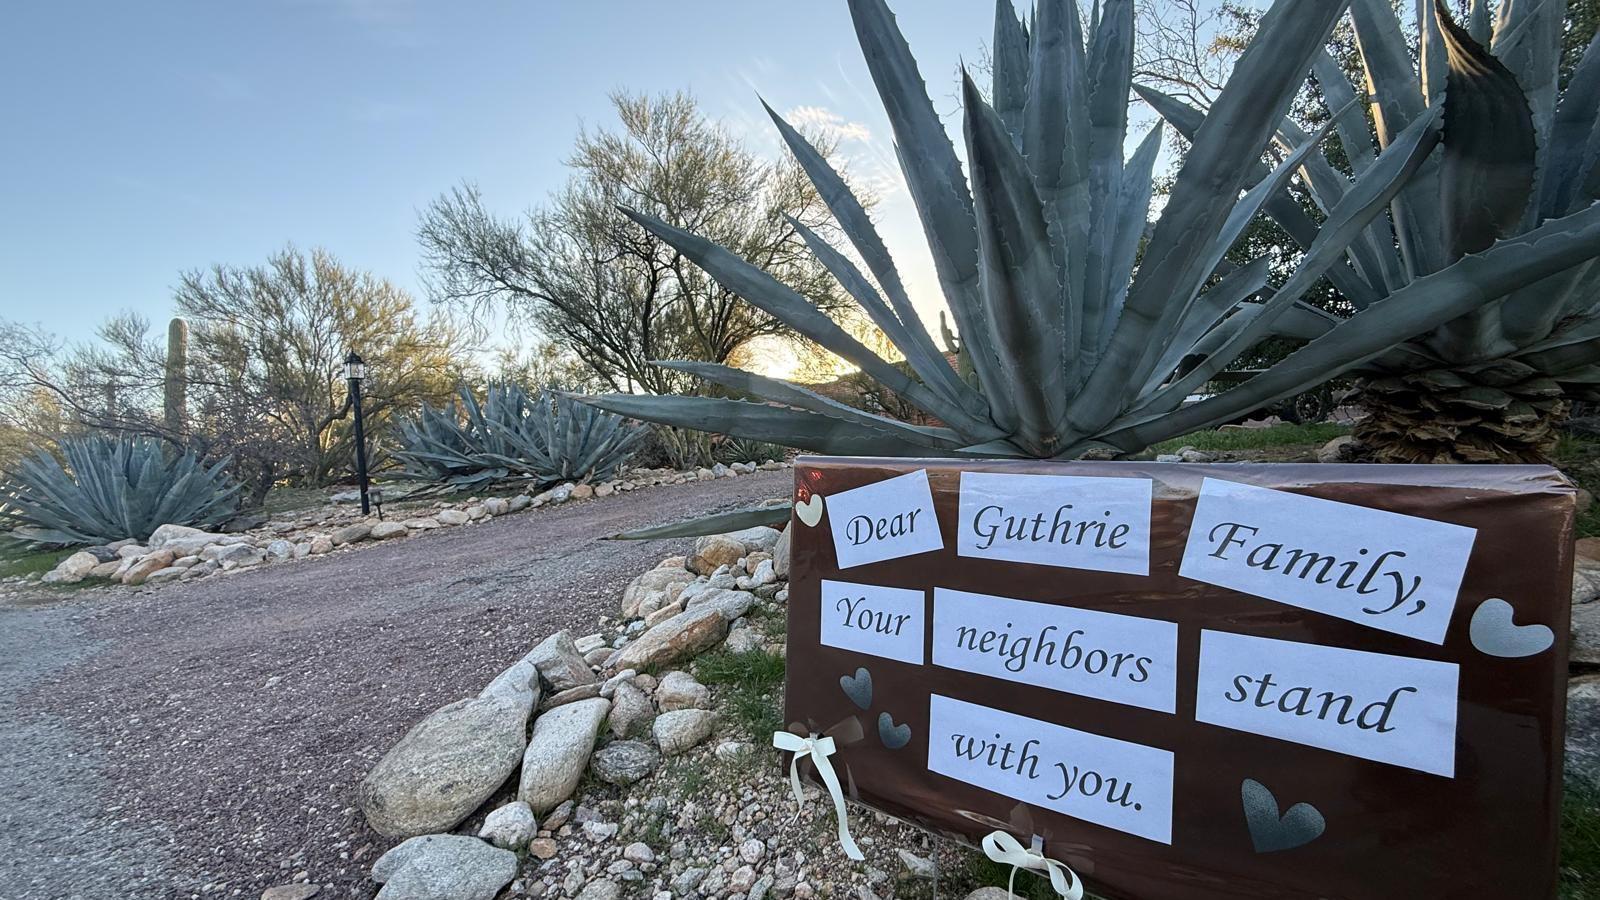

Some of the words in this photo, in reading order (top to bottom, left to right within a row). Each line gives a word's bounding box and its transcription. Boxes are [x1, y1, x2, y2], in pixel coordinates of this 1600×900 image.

[846, 509, 922, 546] Dear
[973, 505, 1130, 550] Guthrie
[1208, 523, 1427, 617] Family,
[836, 597, 911, 636] Your
[956, 623, 1153, 683] neighbors
[1225, 674, 1418, 734] stand
[951, 734, 1041, 780] with
[1047, 763, 1142, 812] you.
